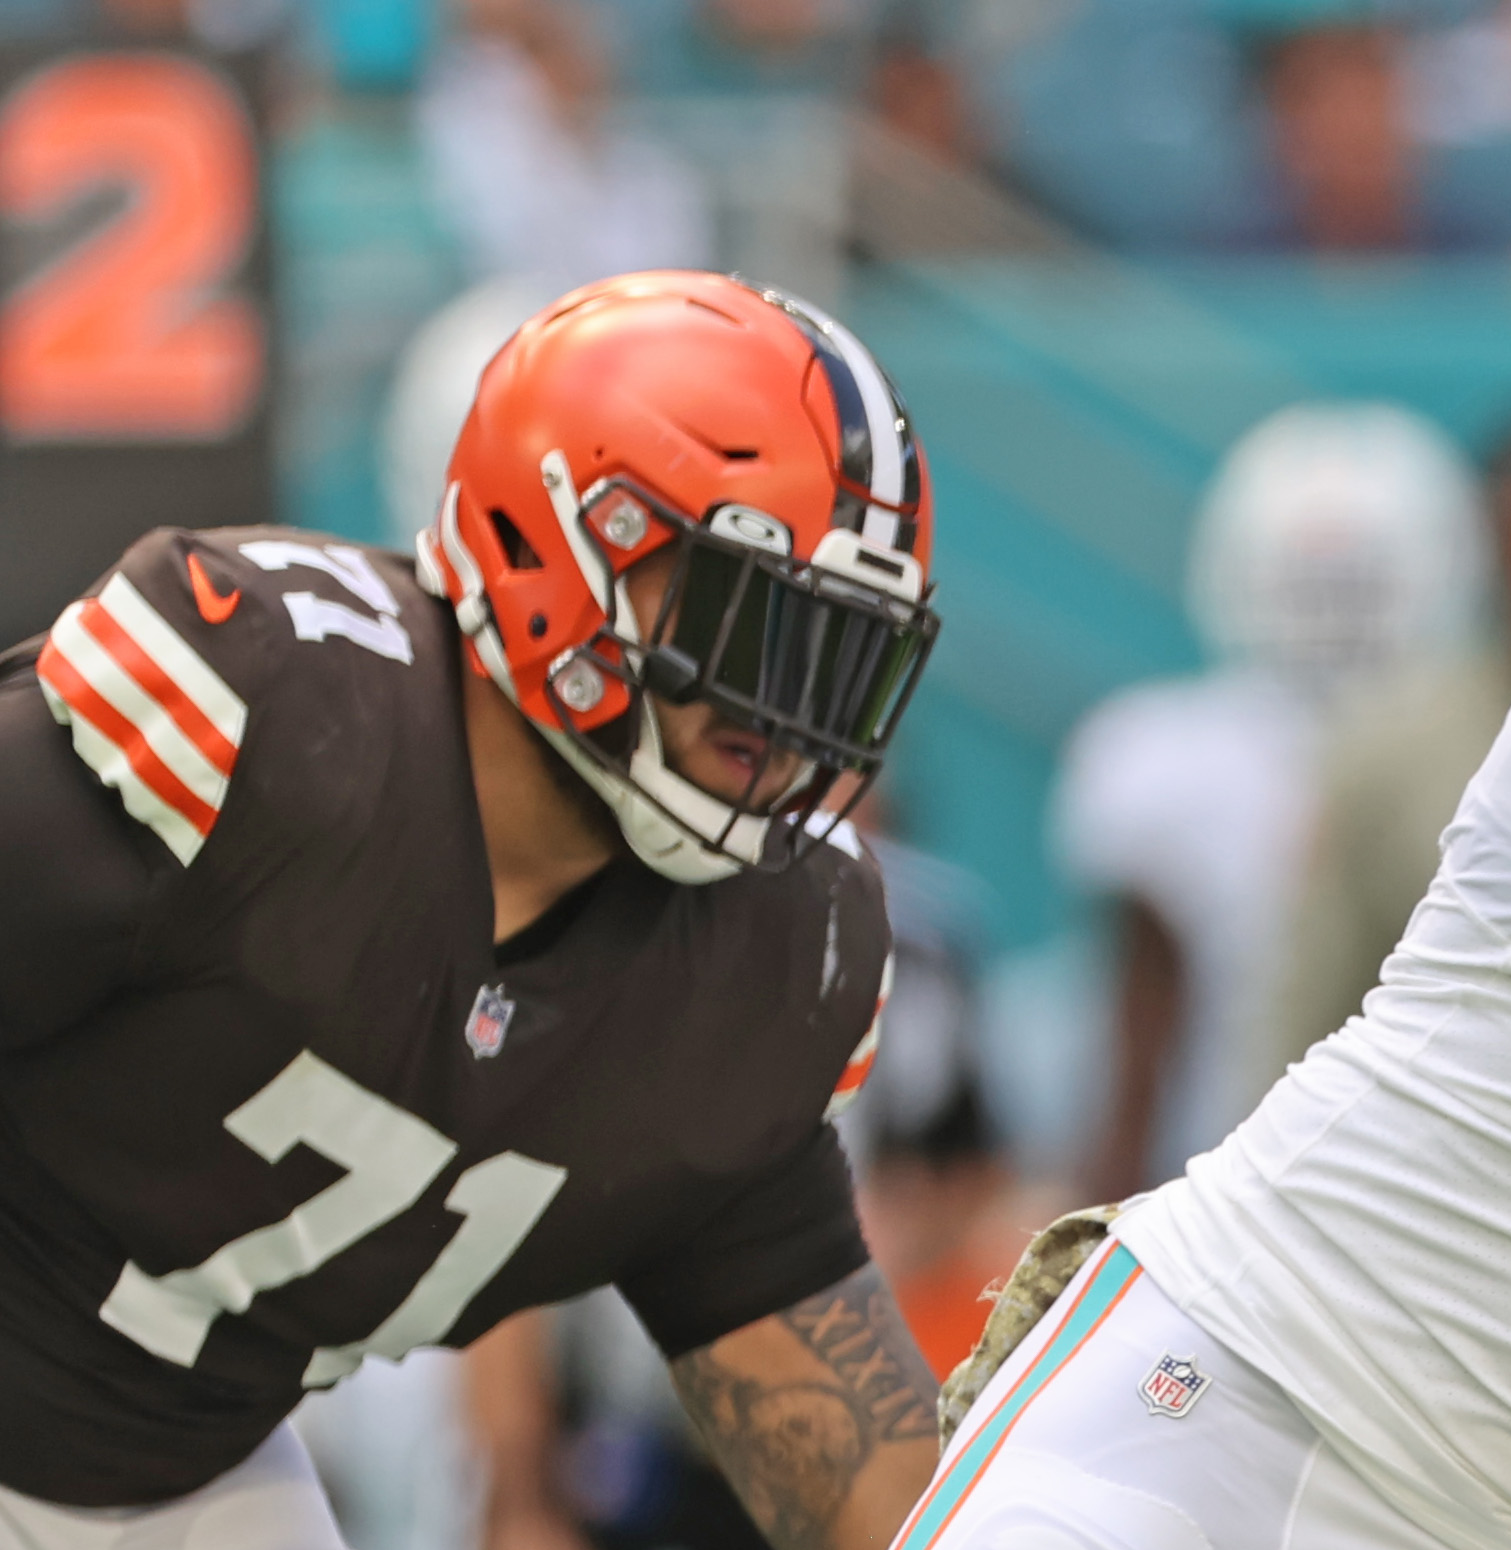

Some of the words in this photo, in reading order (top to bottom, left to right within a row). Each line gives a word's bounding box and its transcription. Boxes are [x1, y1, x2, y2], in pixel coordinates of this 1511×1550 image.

[0, 54, 265, 440] 2
[99, 1048, 568, 1390] 71
[1146, 1371, 1189, 1409] NFL
